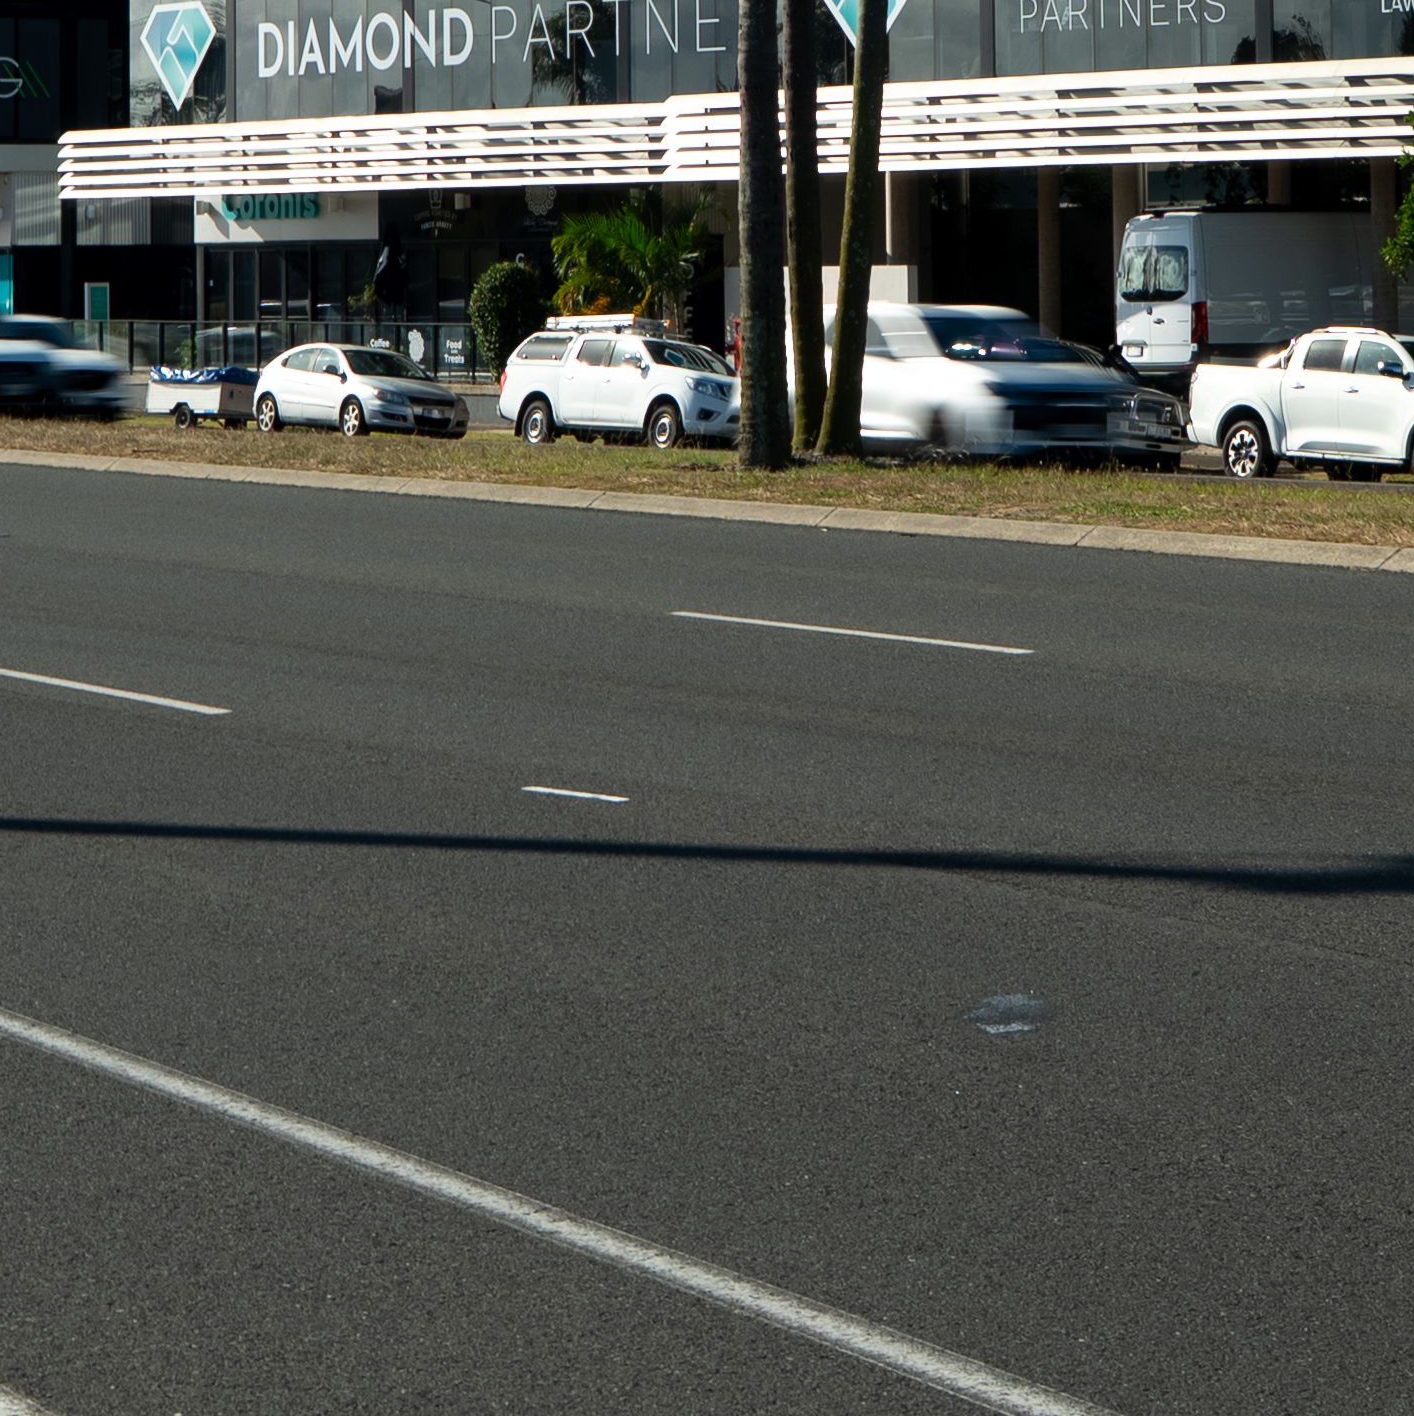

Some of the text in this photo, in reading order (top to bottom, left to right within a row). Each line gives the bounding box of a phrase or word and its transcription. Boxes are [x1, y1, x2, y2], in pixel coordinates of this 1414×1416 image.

[257, 6, 475, 79] DIAMOND
[446, 339, 463, 350] Food
[444, 353, 465, 364] Treats
